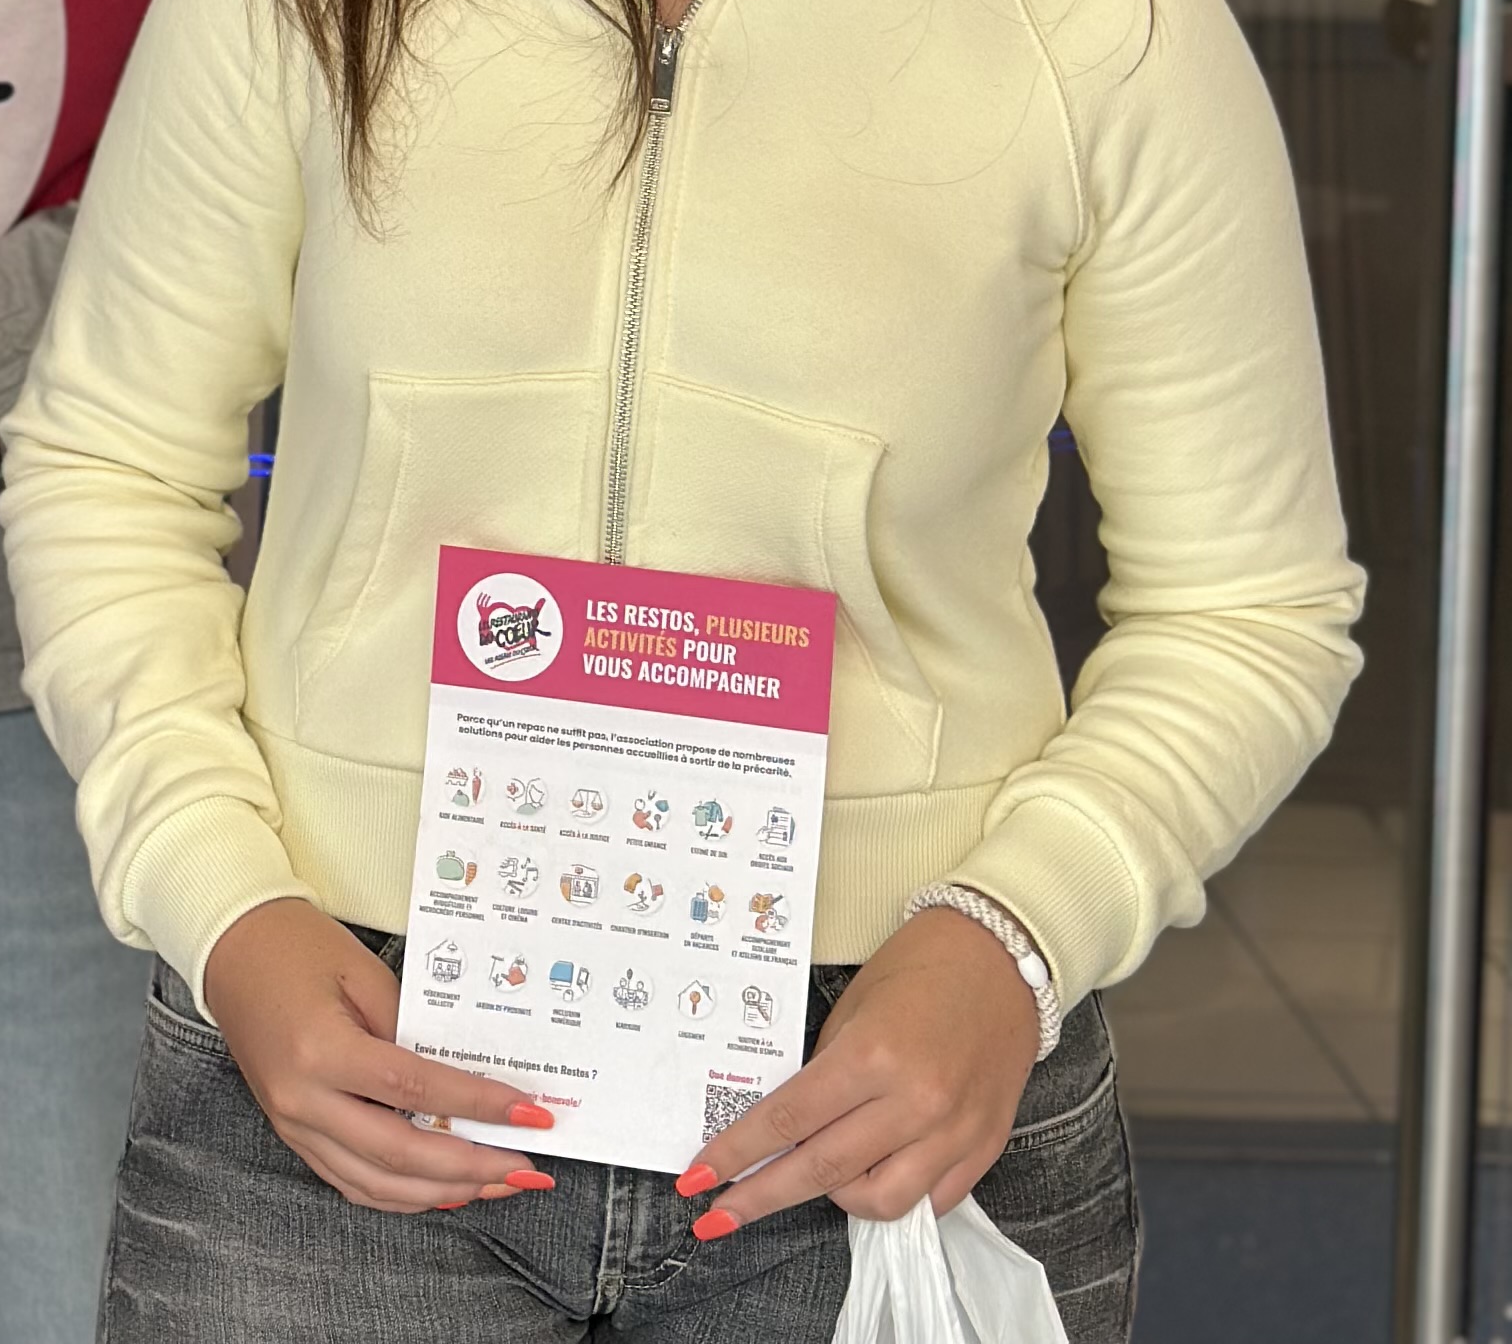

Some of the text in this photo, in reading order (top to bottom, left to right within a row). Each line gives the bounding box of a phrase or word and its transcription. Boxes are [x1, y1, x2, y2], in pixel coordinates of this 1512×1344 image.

[584, 626, 737, 665] ACTIVITÉS POUR
[586, 599, 810, 648] LES RESTOS, PLUSIEURS
[583, 653, 781, 699] VOUS ACCOMPAGNER
[456, 713, 486, 724] Parce
[486, 717, 515, 728] qu'un
[516, 723, 545, 733] repas
[547, 726, 559, 734] ne
[610, 733, 674, 750] l'association
[675, 743, 717, 755] propose
[718, 748, 731, 757] de
[732, 750, 796, 766] nombreuses
[458, 725, 792, 778] solutions pour aider les personnes accueillies à sortir de la précarité.
[415, 1043, 437, 1057] Envie
[439, 1047, 450, 1057] de
[451, 1048, 491, 1064] rejoindre
[493, 1054, 506, 1067] les
[508, 1057, 541, 1072] équipes
[543, 1062, 558, 1074] des
[560, 1065, 590, 1078] Restos
